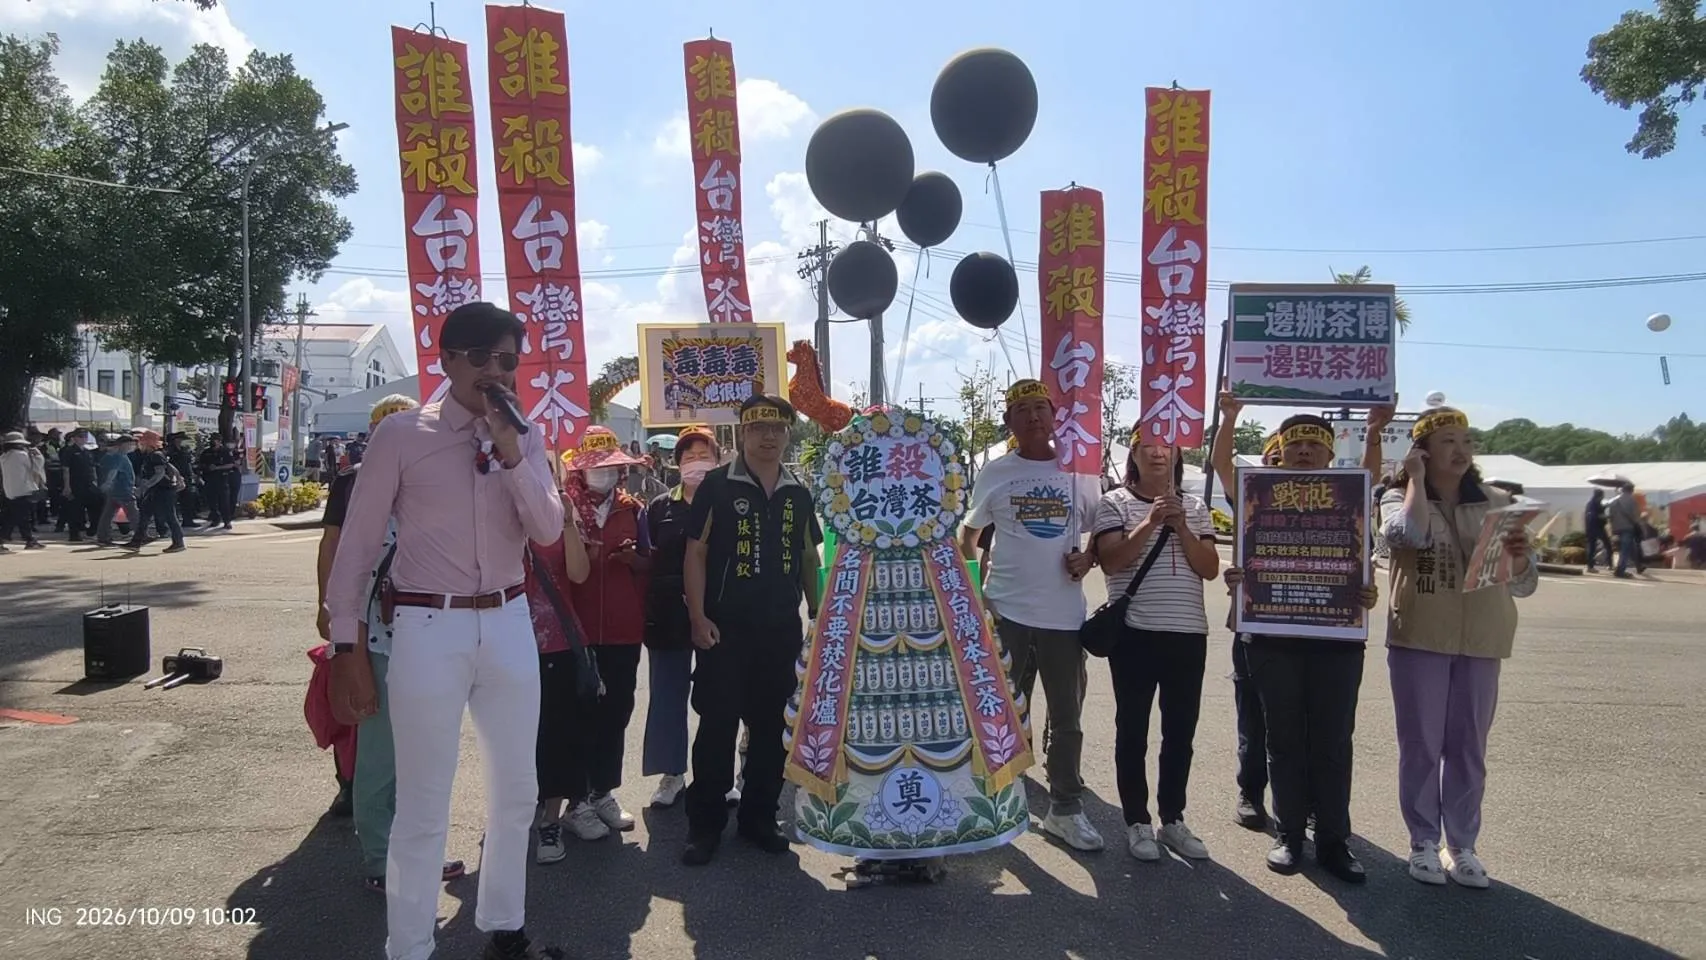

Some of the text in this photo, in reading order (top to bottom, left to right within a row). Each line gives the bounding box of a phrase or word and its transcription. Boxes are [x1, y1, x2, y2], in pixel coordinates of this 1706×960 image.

[690, 53, 750, 322] 誰殺台灣茶
[494, 27, 588, 445] 誰殺台灣茶
[1143, 92, 1207, 444] 誰殺台灣茶
[1235, 301, 1390, 338] 一邊辦茶博
[674, 345, 758, 377] 毒毒毒
[1234, 345, 1389, 381] 一邊毀茶鄉
[845, 443, 933, 483] 誰殺
[851, 483, 941, 521] 台灣茶
[1271, 481, 1334, 512] 戰帖
[809, 548, 861, 726] 名間不要焚化爐
[932, 545, 1005, 718] 守護台灣本土茶
[893, 770, 932, 814] 奠
